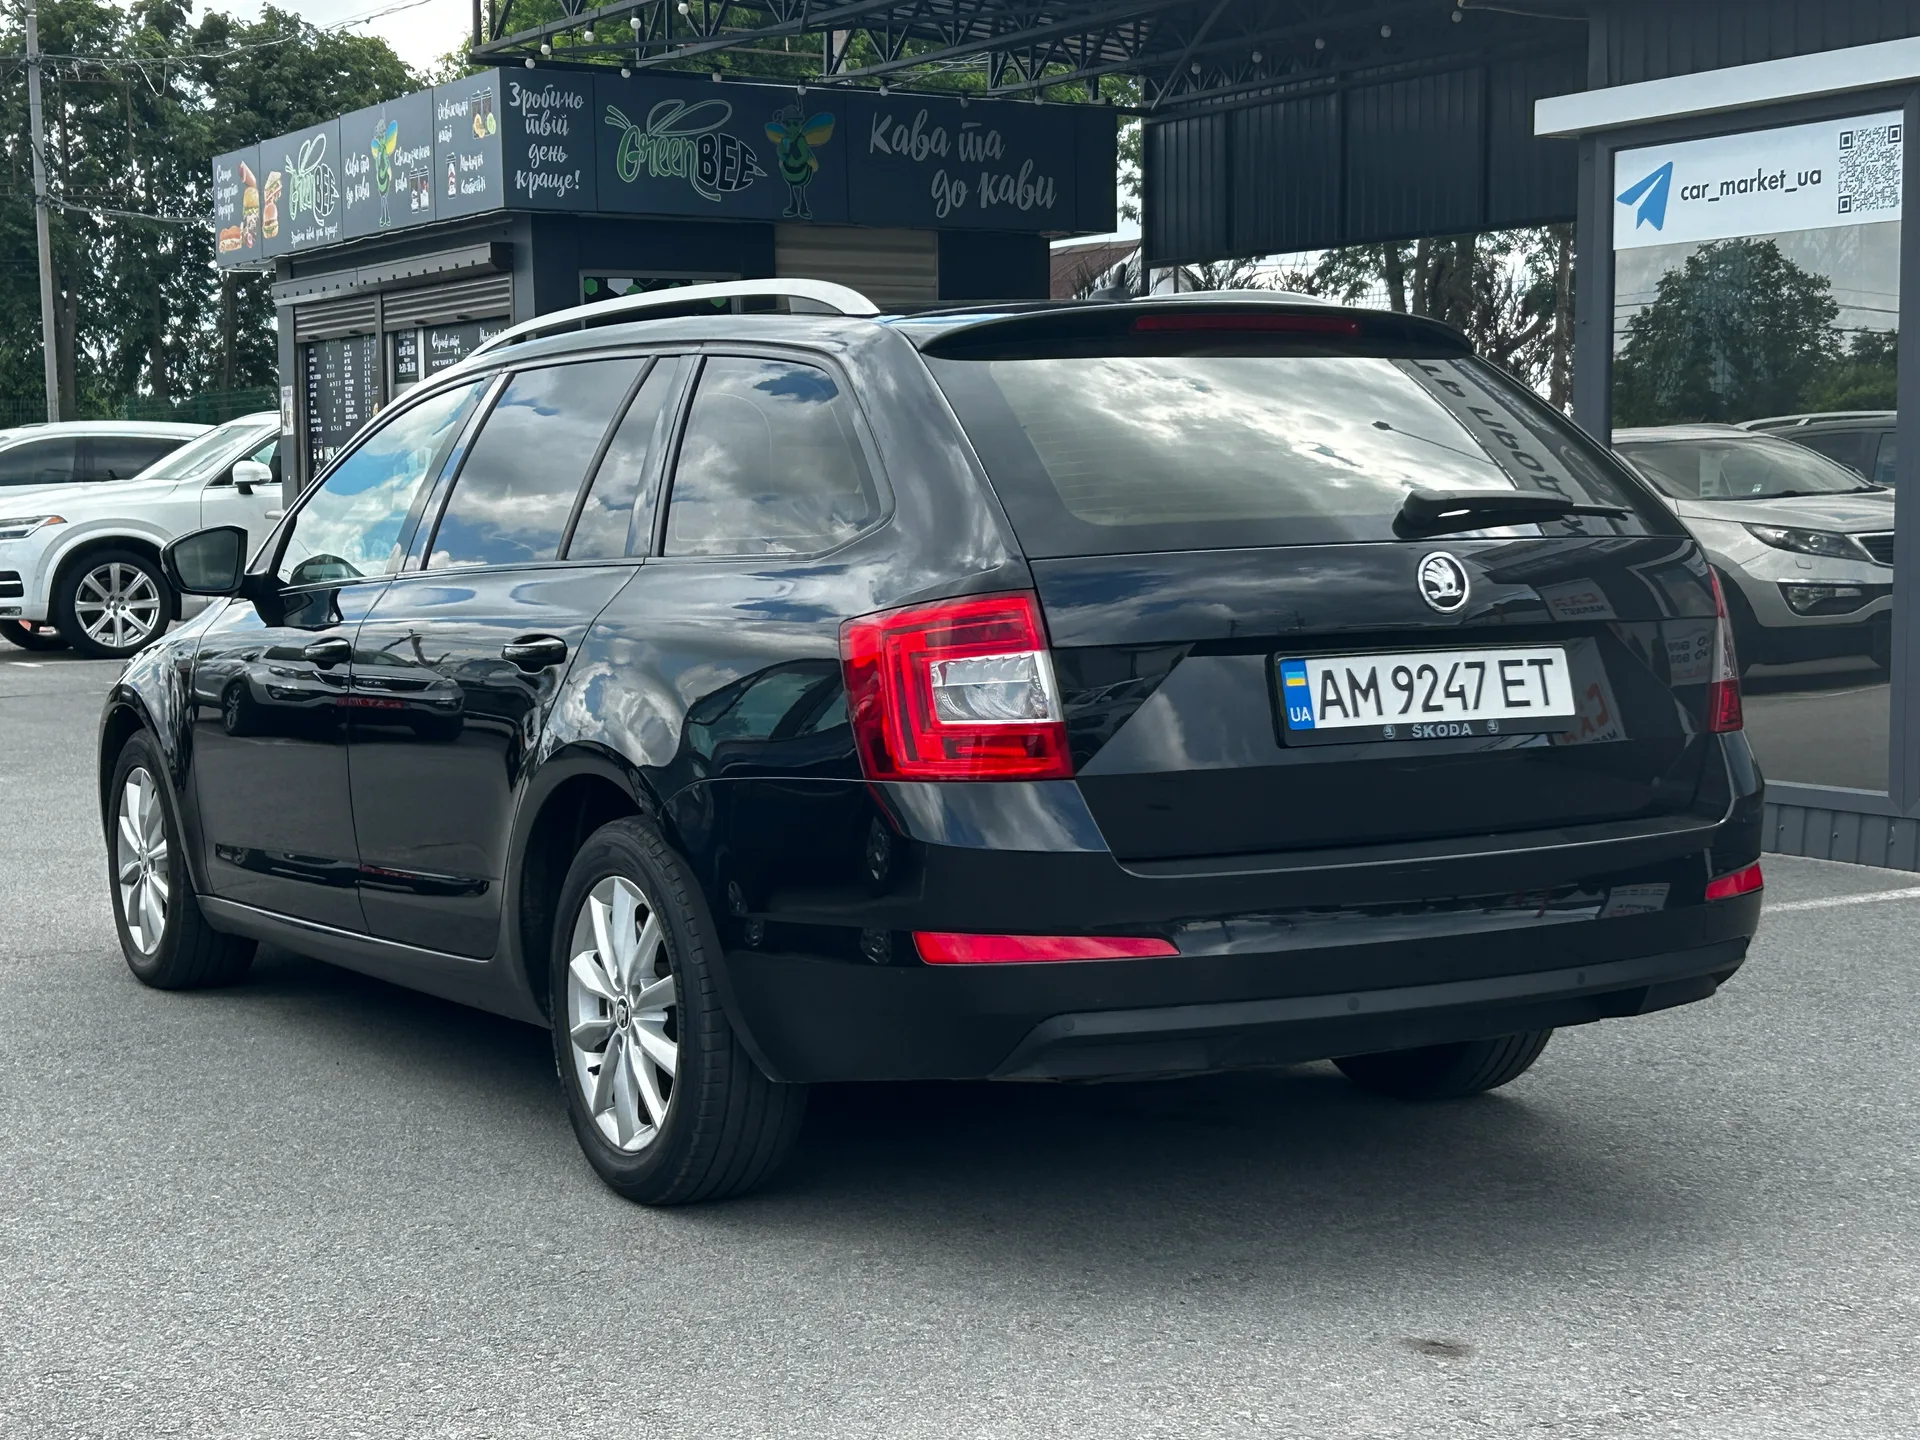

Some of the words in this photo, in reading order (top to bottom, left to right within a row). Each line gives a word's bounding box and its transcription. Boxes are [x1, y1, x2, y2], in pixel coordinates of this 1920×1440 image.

[525, 109, 570, 137] твій
[869, 108, 951, 162] Кава
[958, 121, 1006, 162] та
[528, 142, 569, 169] день
[514, 169, 581, 199] краще!
[930, 168, 969, 219] до
[976, 158, 1058, 211] кави
[1680, 167, 1822, 202] car_market_ua
[1318, 665, 1384, 721] AM
[1390, 660, 1487, 715] 9247
[1498, 657, 1554, 708] ET
[1290, 706, 1312, 724] UA
